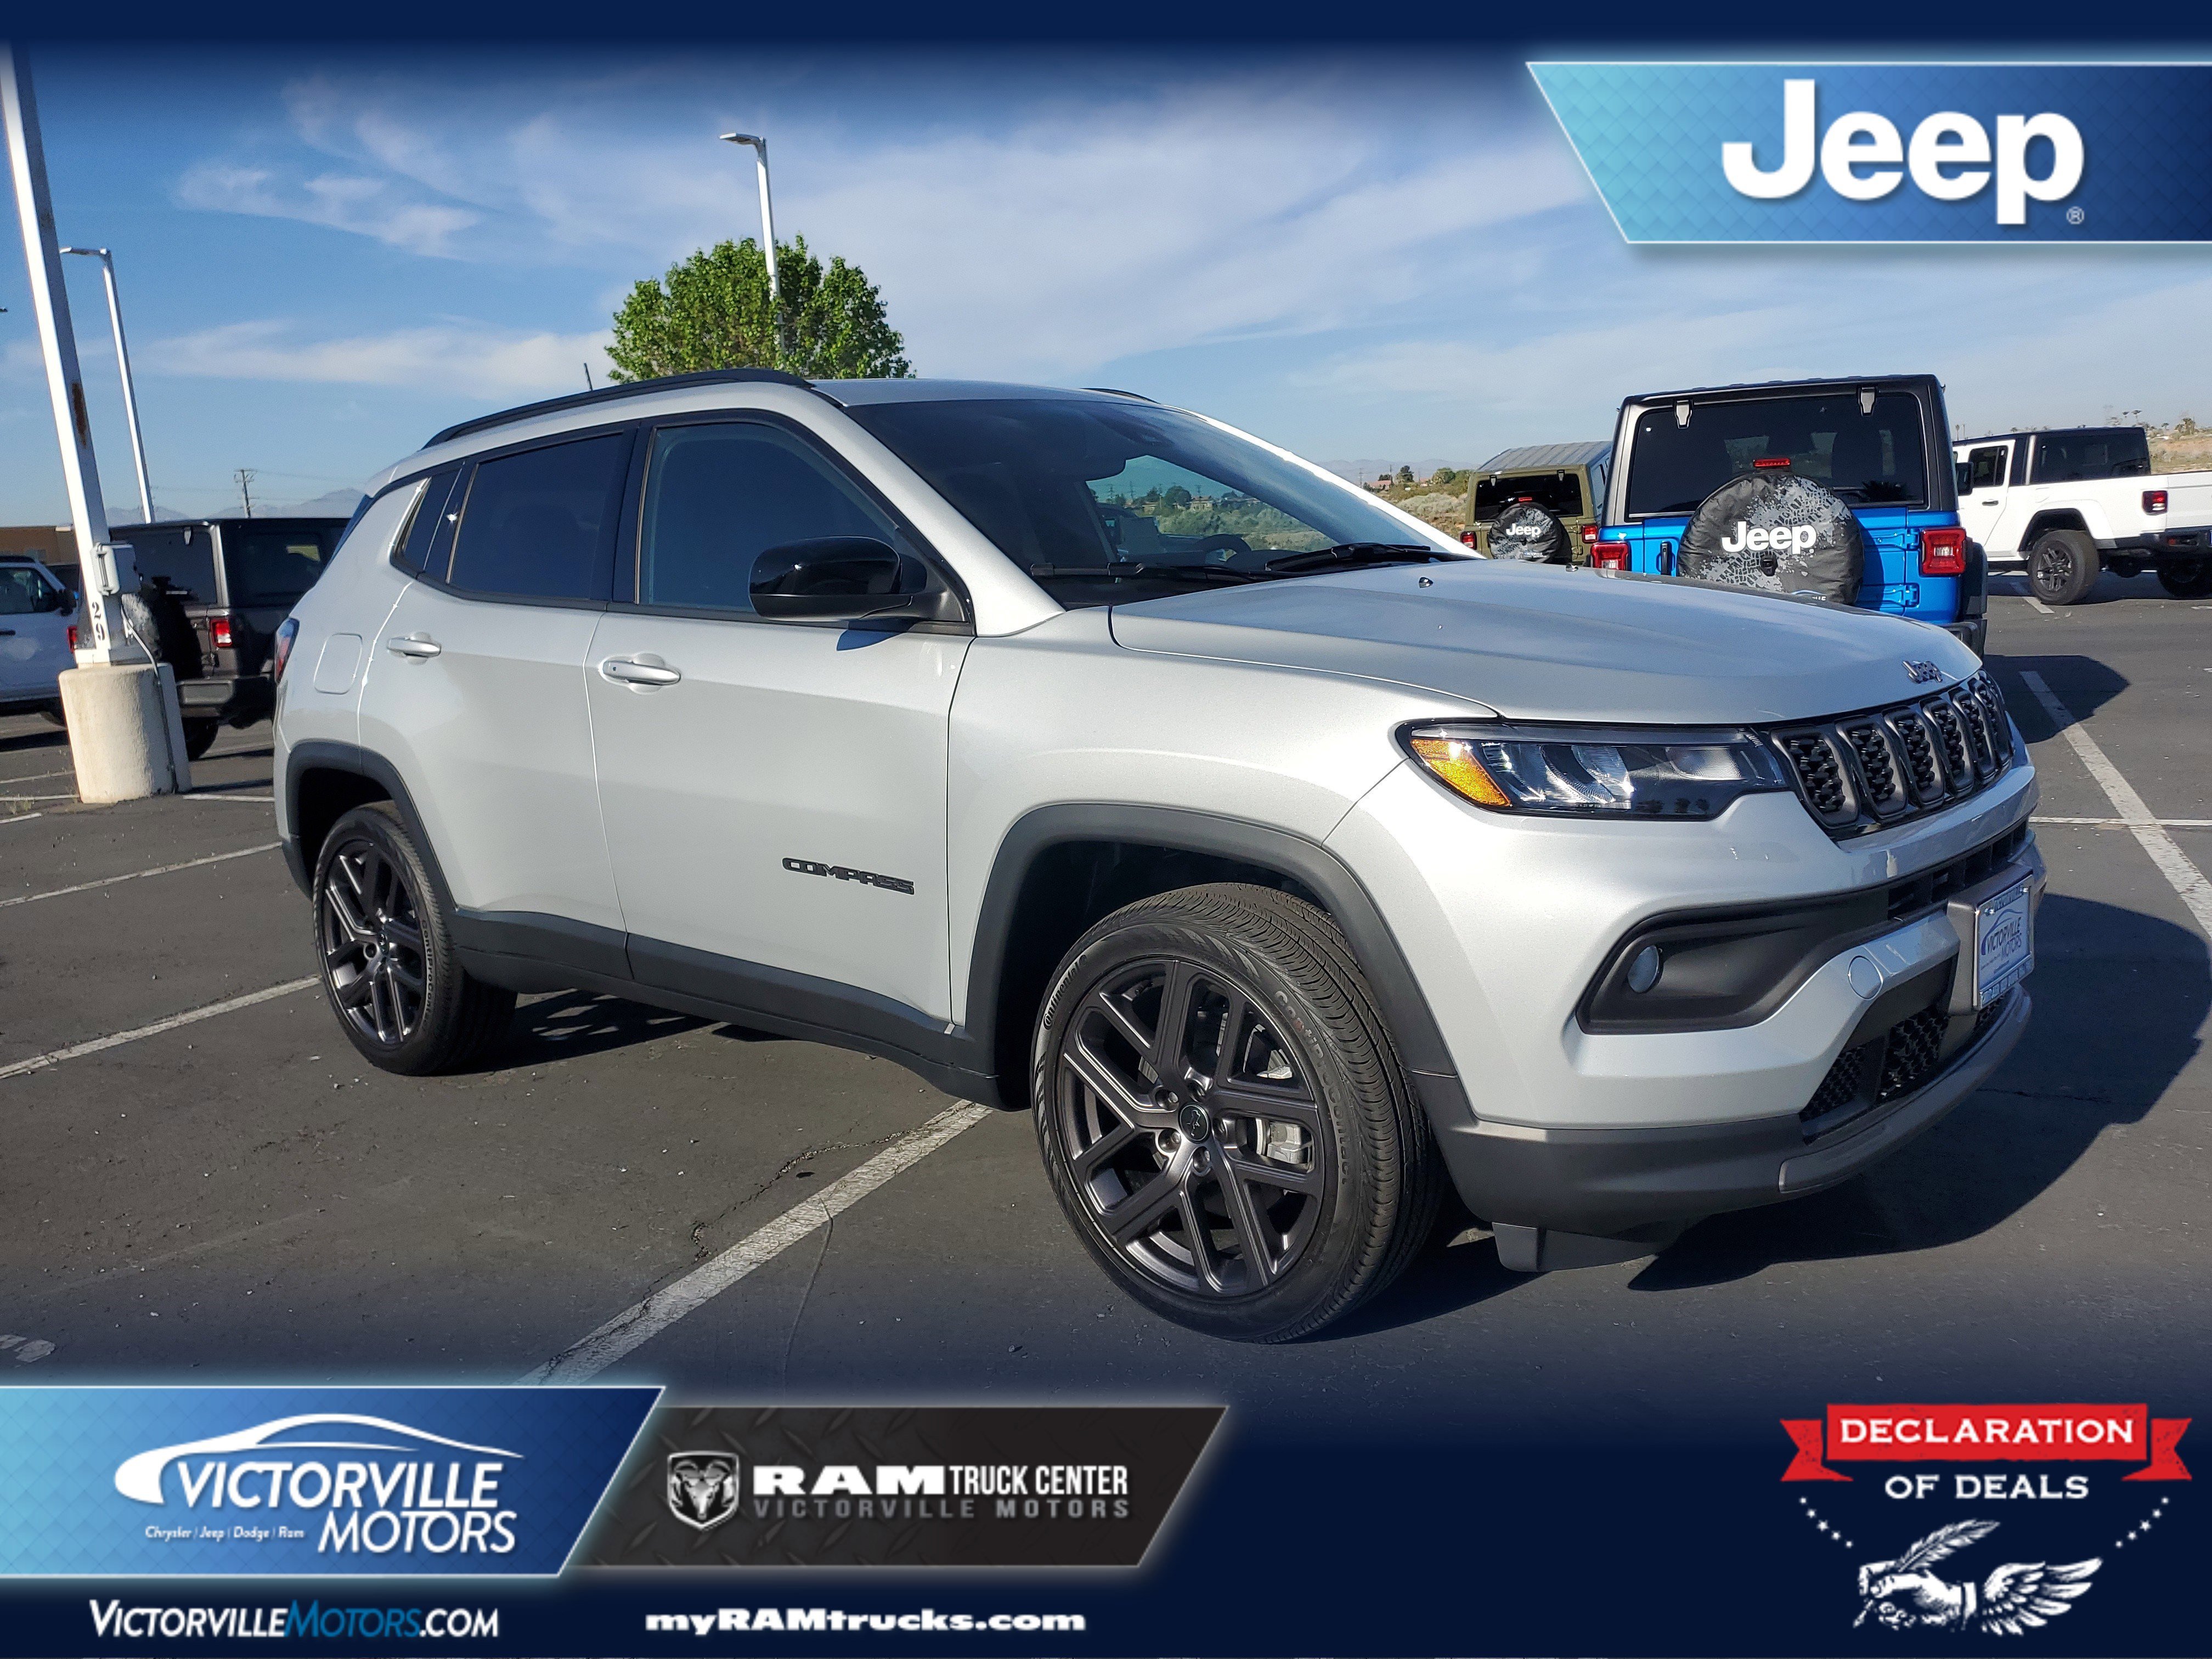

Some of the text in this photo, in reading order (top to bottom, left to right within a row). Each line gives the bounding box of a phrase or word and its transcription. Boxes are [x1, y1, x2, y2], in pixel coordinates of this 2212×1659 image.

[1506, 523, 1541, 537] Jeep
[1722, 521, 1816, 555] Jeep
[1902, 660, 1943, 684] Jeep
[782, 857, 915, 895] COMPASS
